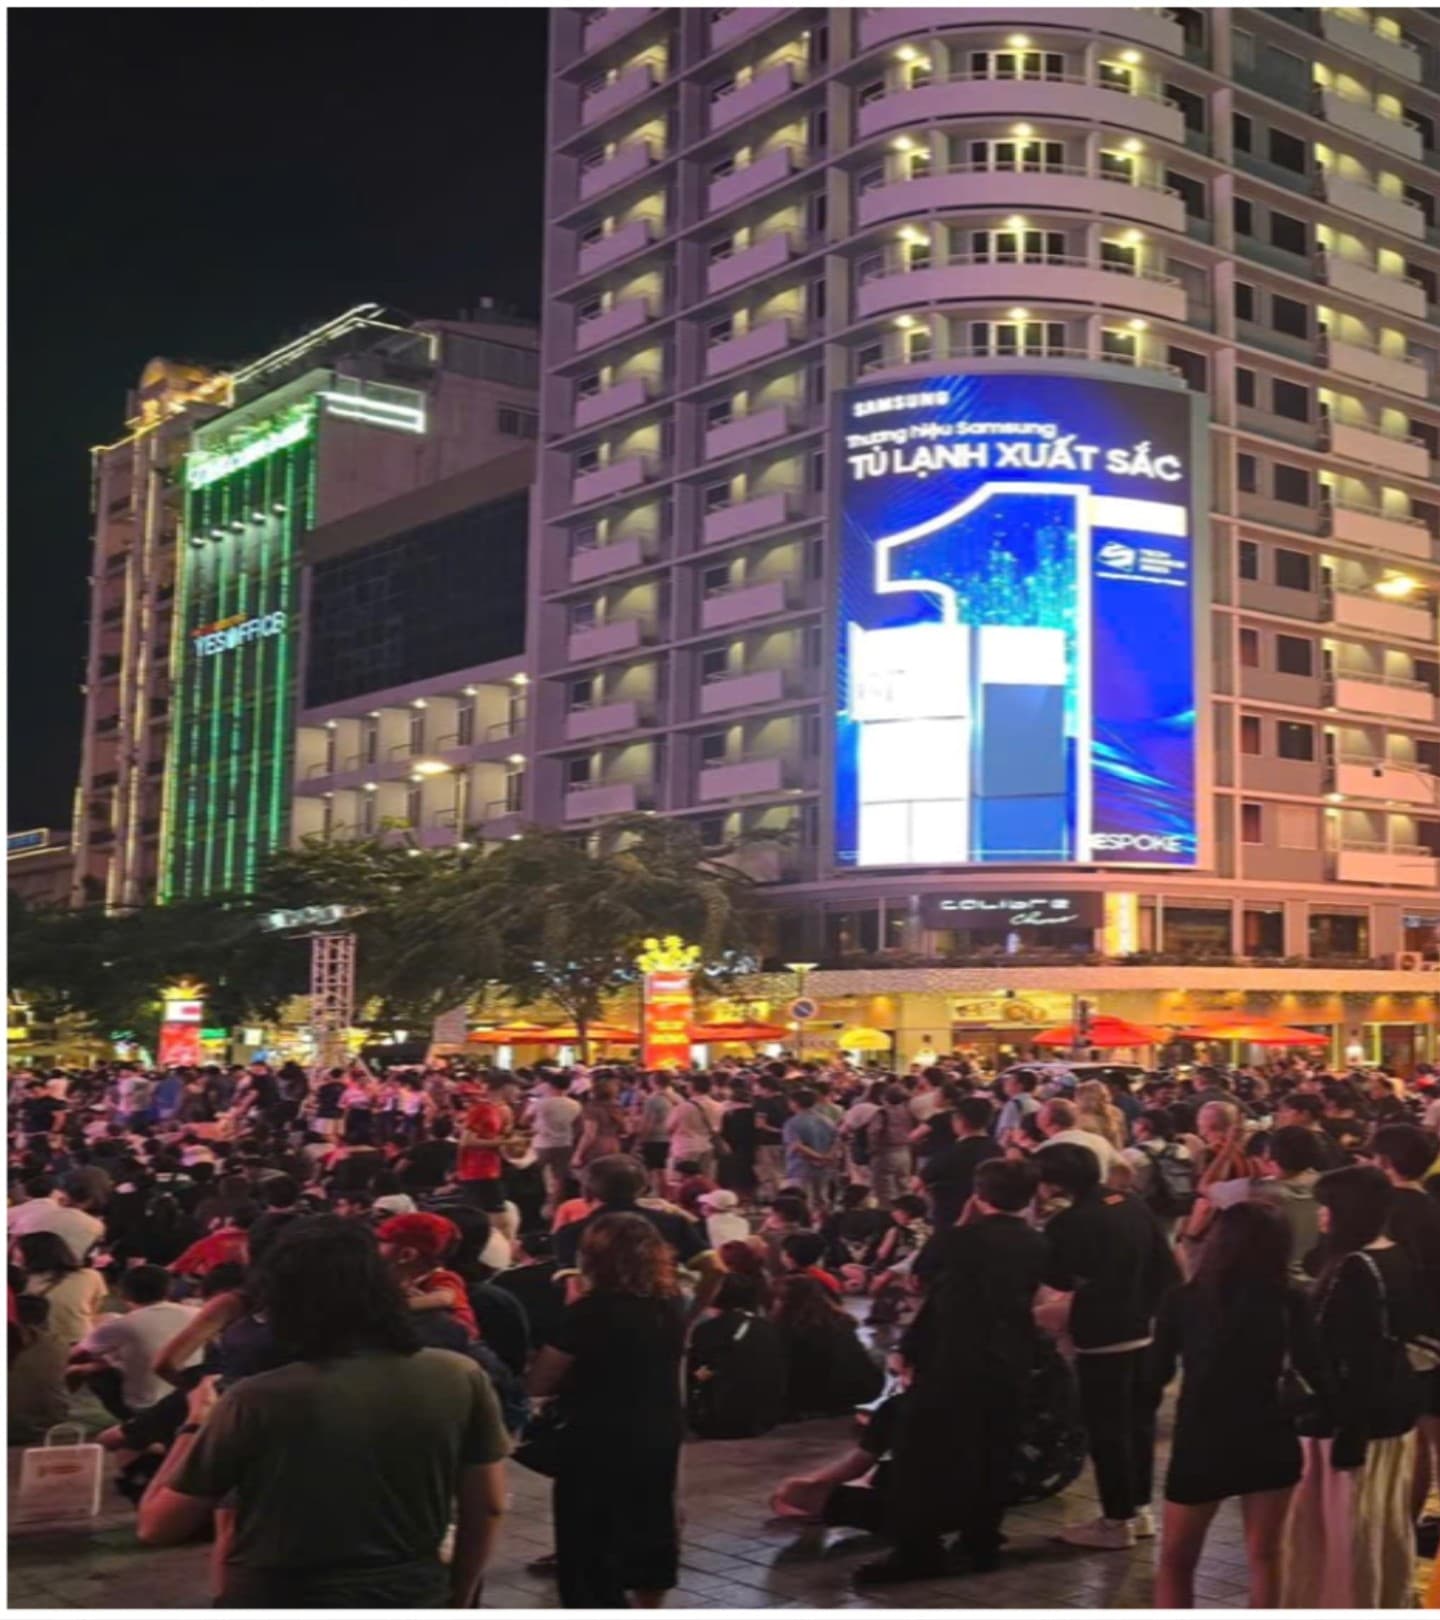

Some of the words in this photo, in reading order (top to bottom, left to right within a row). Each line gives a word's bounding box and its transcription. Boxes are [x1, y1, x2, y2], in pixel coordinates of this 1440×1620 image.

[853, 391, 949, 417] SAMSUNG
[957, 420, 1057, 439] Samsung
[848, 445, 888, 480] TỦ
[892, 443, 988, 478] LẠNH
[995, 434, 1100, 471] XUẤT
[1105, 440, 1183, 482] SẮC
[1088, 833, 1182, 853] ESPOKE
